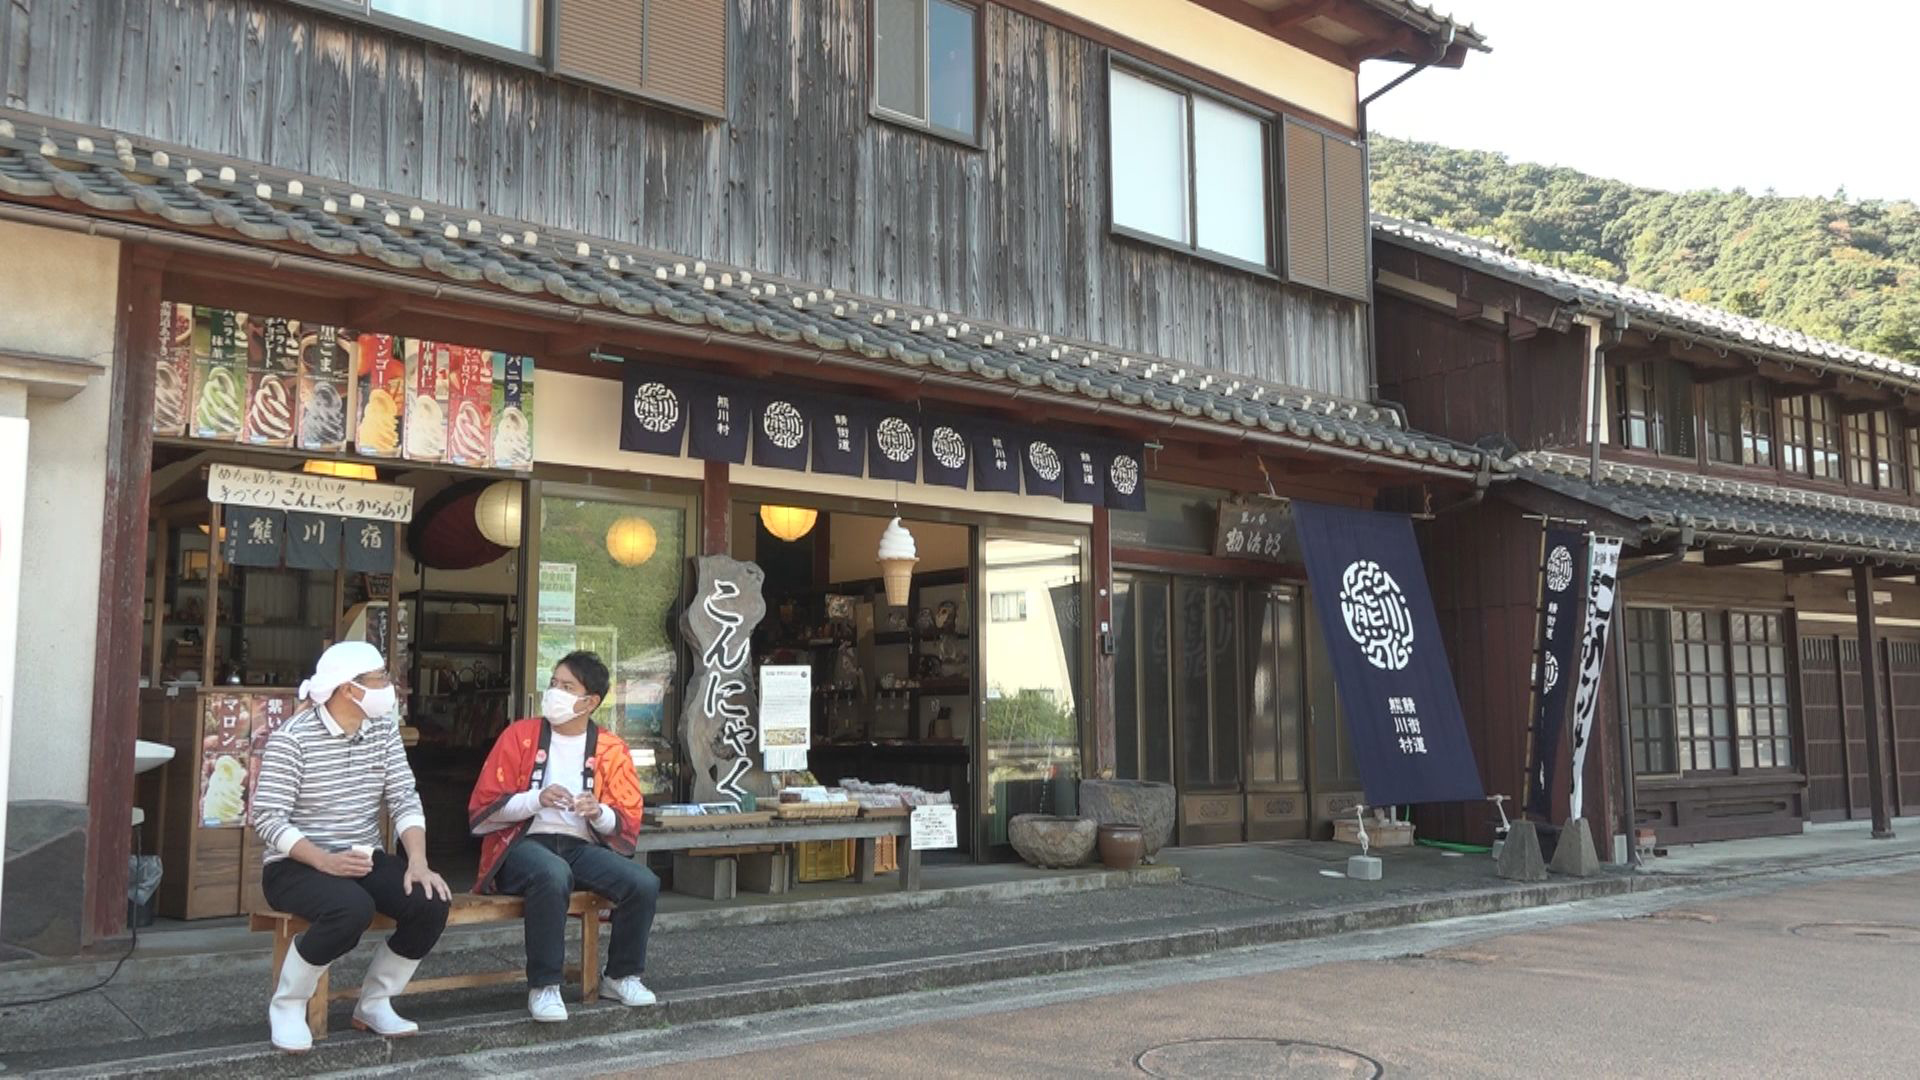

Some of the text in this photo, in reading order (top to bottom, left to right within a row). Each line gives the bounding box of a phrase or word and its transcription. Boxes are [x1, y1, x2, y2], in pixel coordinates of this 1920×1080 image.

[319, 325, 336, 373] 黒ごま
[375, 333, 390, 384] マンゴー
[506, 354, 522, 394] バニラ
[716, 394, 730, 437] 熊川村
[703, 578, 758, 803] こんにゃく
[222, 699, 238, 747] マロン
[1388, 696, 1415, 755] 熊川村
[1401, 696, 1428, 755] 鯖街道
